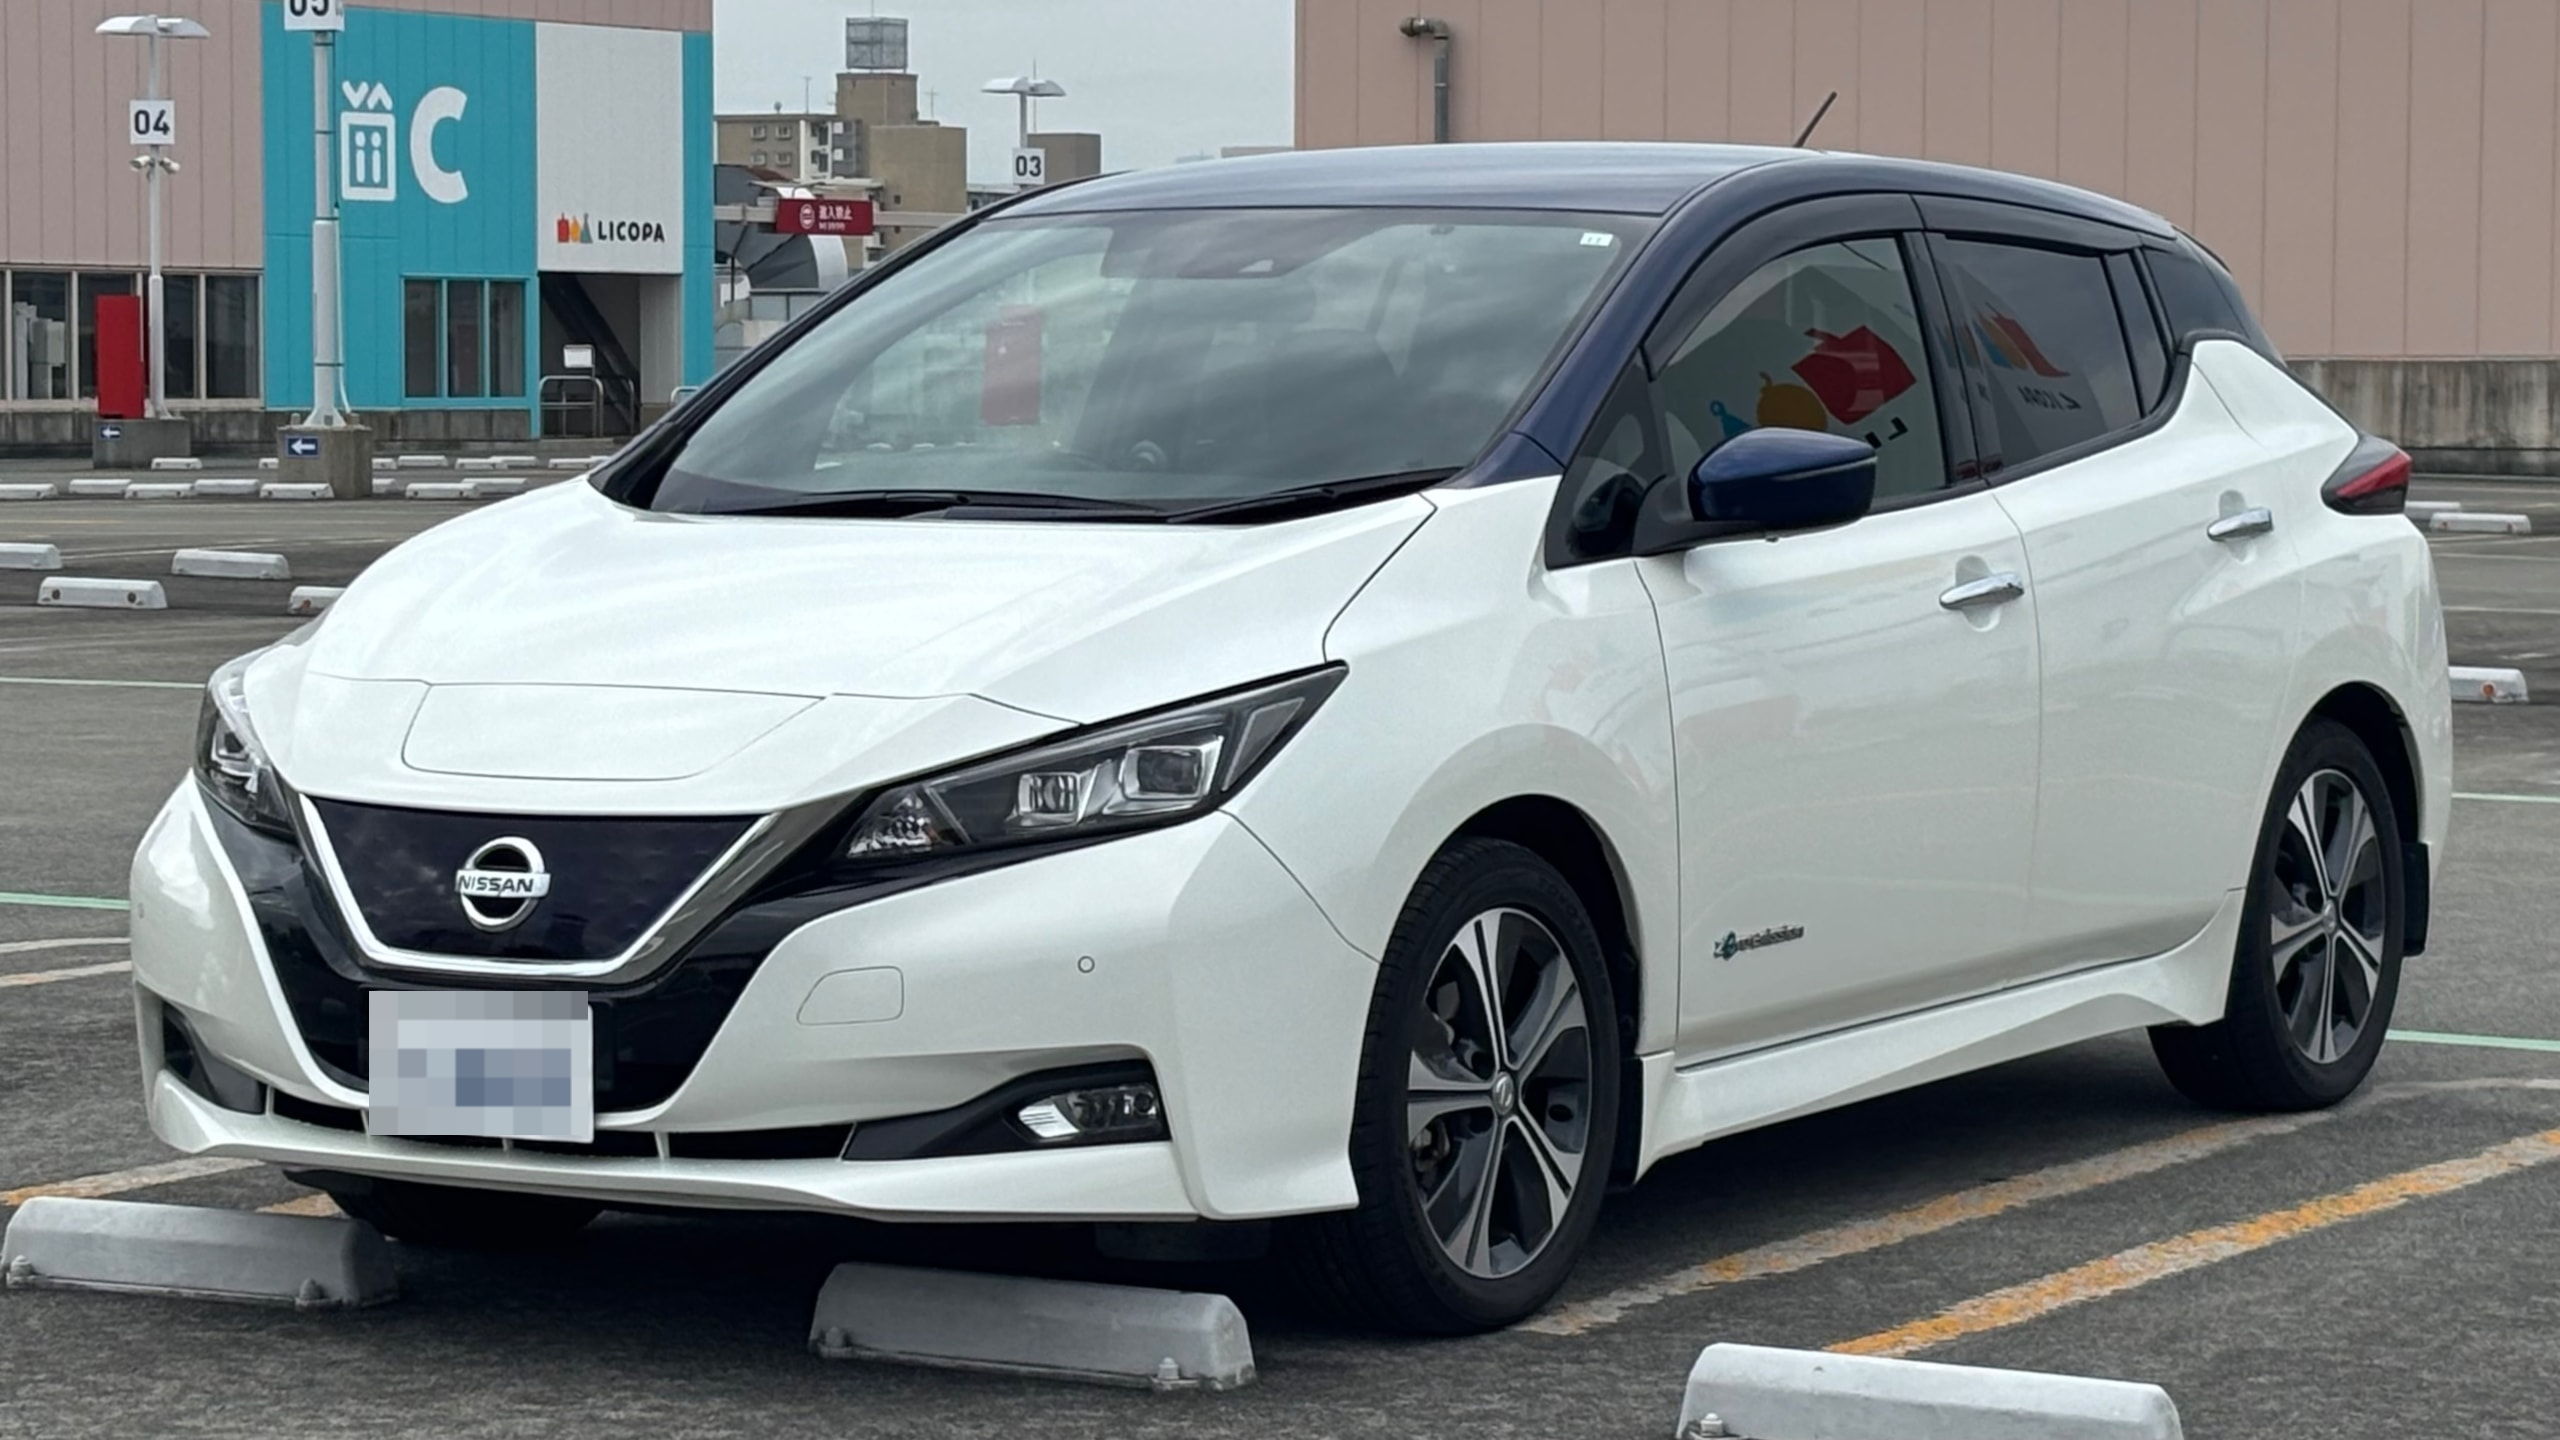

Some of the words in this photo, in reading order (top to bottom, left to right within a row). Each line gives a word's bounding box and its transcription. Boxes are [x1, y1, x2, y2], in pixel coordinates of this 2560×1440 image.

[134, 109, 170, 135] 04
[409, 86, 468, 203] C
[1015, 155, 1042, 177] 03
[598, 220, 665, 242] LICOPA
[459, 875, 534, 893] NISSAN
